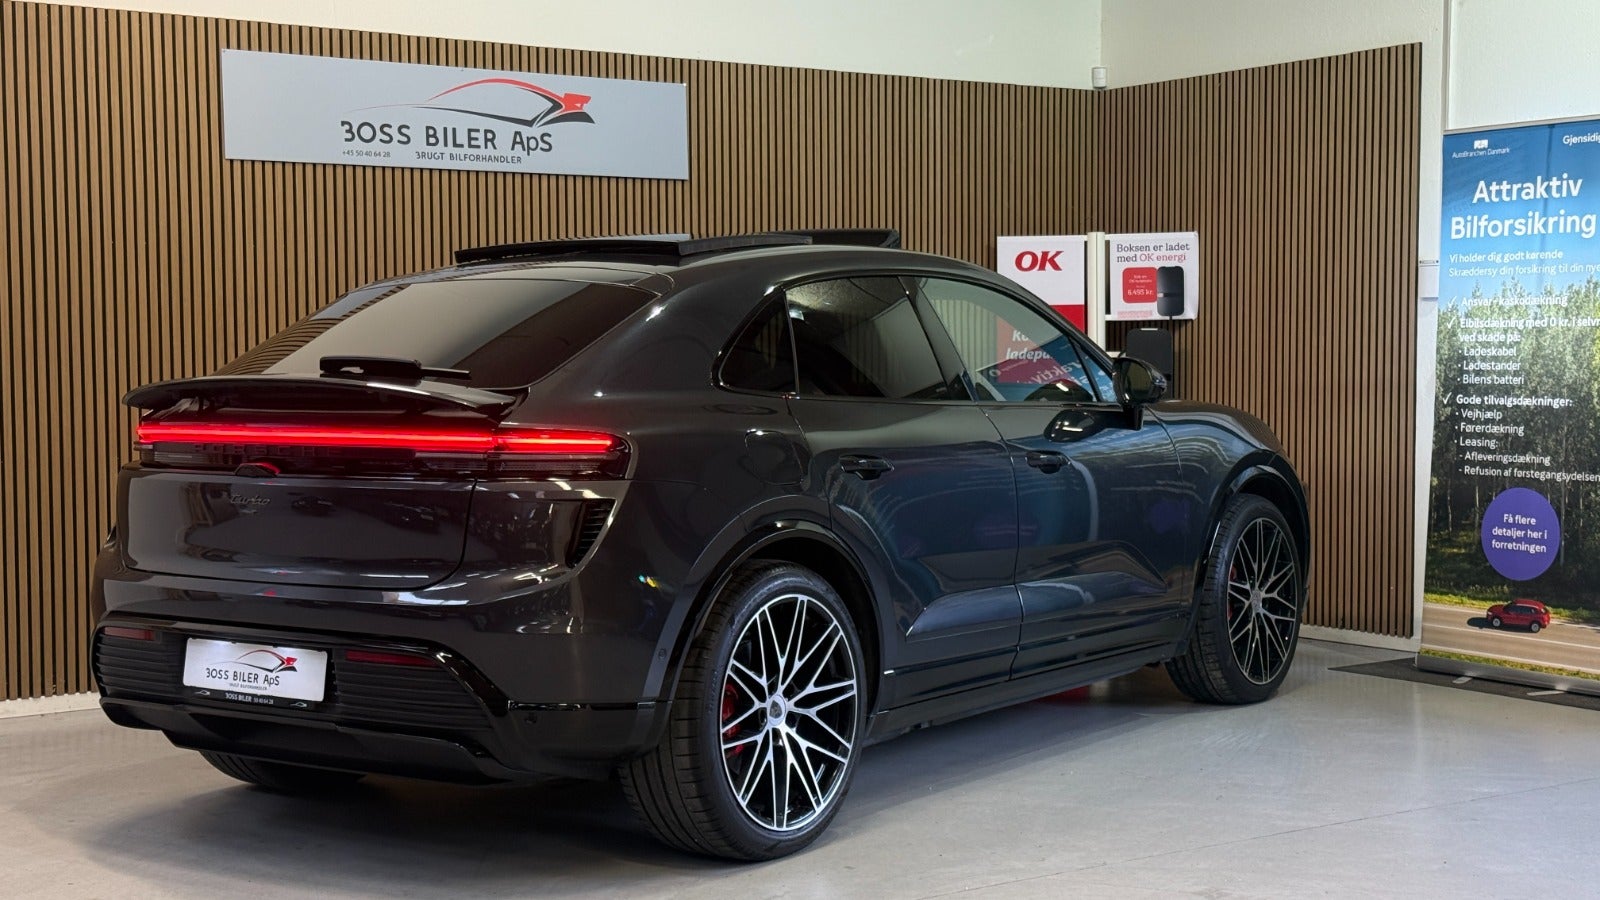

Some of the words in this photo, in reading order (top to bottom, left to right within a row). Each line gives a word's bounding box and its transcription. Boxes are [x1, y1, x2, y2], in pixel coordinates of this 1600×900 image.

[425, 125, 497, 150] BILER
[510, 131, 553, 156] ApS
[1487, 147, 1510, 155] Danmark
[449, 153, 522, 164] BILFORHANDLER
[1472, 172, 1583, 203] Attraktiv
[1451, 209, 1597, 239] Bilforsikring
[1116, 243, 1150, 253] Boksen
[1165, 242, 1190, 251] ladet
[1014, 250, 1064, 272] OK
[1116, 254, 1137, 263] med
[1139, 253, 1154, 262] OK
[1156, 252, 1186, 263] energi
[1450, 254, 1458, 263] Vi
[1459, 253, 1486, 262] holder
[1487, 251, 1501, 264] dig
[1503, 251, 1525, 263] godt
[1525, 249, 1563, 260] kørende
[1449, 266, 1498, 278] Skræddersy
[1499, 265, 1514, 276] din
[1515, 264, 1557, 276] forsikring
[1558, 264, 1568, 273] til
[1570, 263, 1583, 273] din
[1525, 317, 1547, 328] med
[1559, 317, 1570, 327] kr.
[1460, 332, 1476, 342] ved
[1477, 332, 1505, 342] skade
[1464, 346, 1517, 357] Ladeskabel
[1463, 360, 1521, 371] Ladestander
[1463, 374, 1492, 385] Bilens
[1494, 374, 1525, 385] batteri
[1456, 394, 1482, 405] Gode
[1484, 395, 1573, 409] tilvalgsdækninger:
[1461, 408, 1503, 421] Vejhjælp
[1460, 422, 1524, 436] Førerdækning
[1460, 436, 1499, 450] Leasing:
[1464, 451, 1551, 466] Afleveringsdækning
[1464, 465, 1502, 477] Refusion
[1503, 467, 1512, 477] af
[1503, 513, 1513, 523] Få
[1515, 514, 1536, 525] flere
[1492, 526, 1525, 539] detaljer
[1527, 529, 1542, 538] her
[1492, 539, 1546, 553] forretningen
[233, 671, 258, 684] BILER
[263, 674, 280, 687] ApS
[238, 694, 252, 703] BILER
